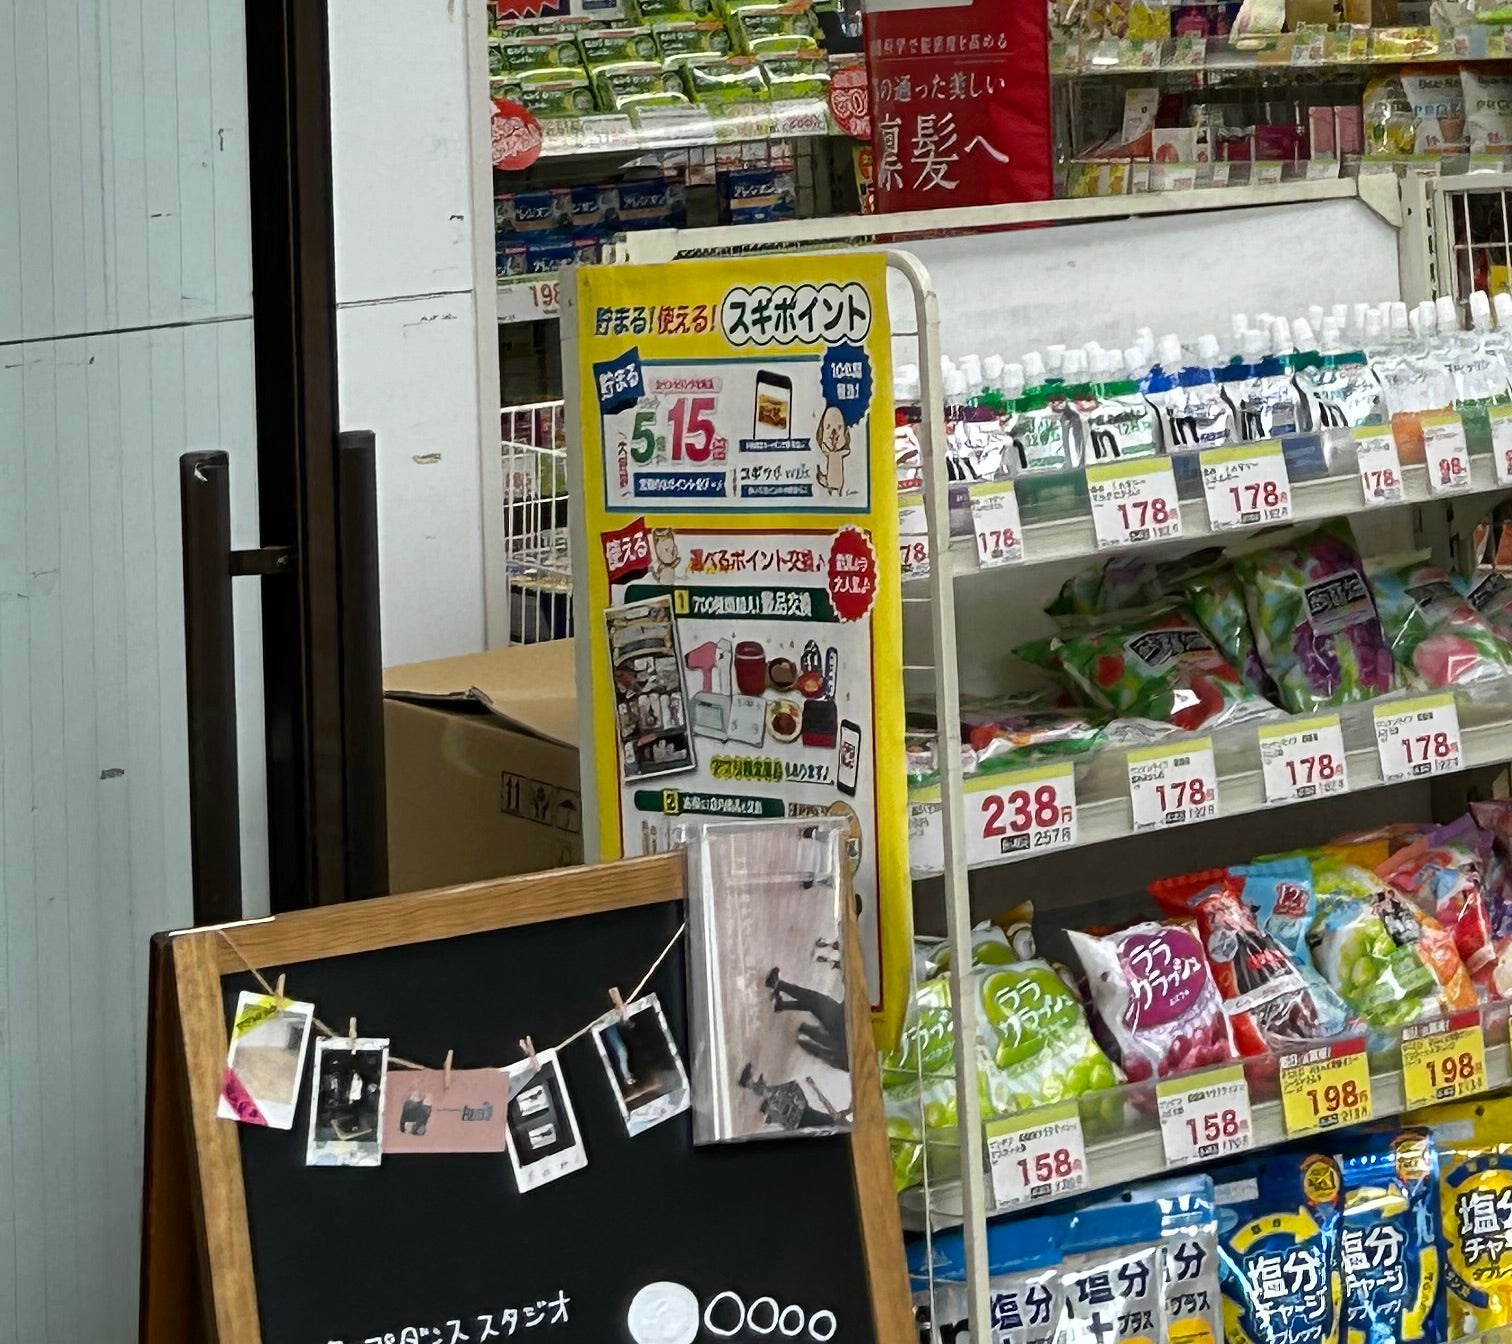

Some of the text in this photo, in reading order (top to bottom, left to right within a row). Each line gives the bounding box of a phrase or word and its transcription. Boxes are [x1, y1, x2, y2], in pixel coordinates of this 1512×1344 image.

[729, 294, 866, 335] スギポイント
[668, 397, 728, 462] 15
[981, 784, 1073, 840] 238円
[1342, 1226, 1404, 1273] 塩分
[1075, 1259, 1150, 1306] 塩分
[1248, 1250, 1322, 1300] 塩分
[478, 1289, 572, 1342] スタジオ
[990, 1284, 1053, 1331] 塩分
